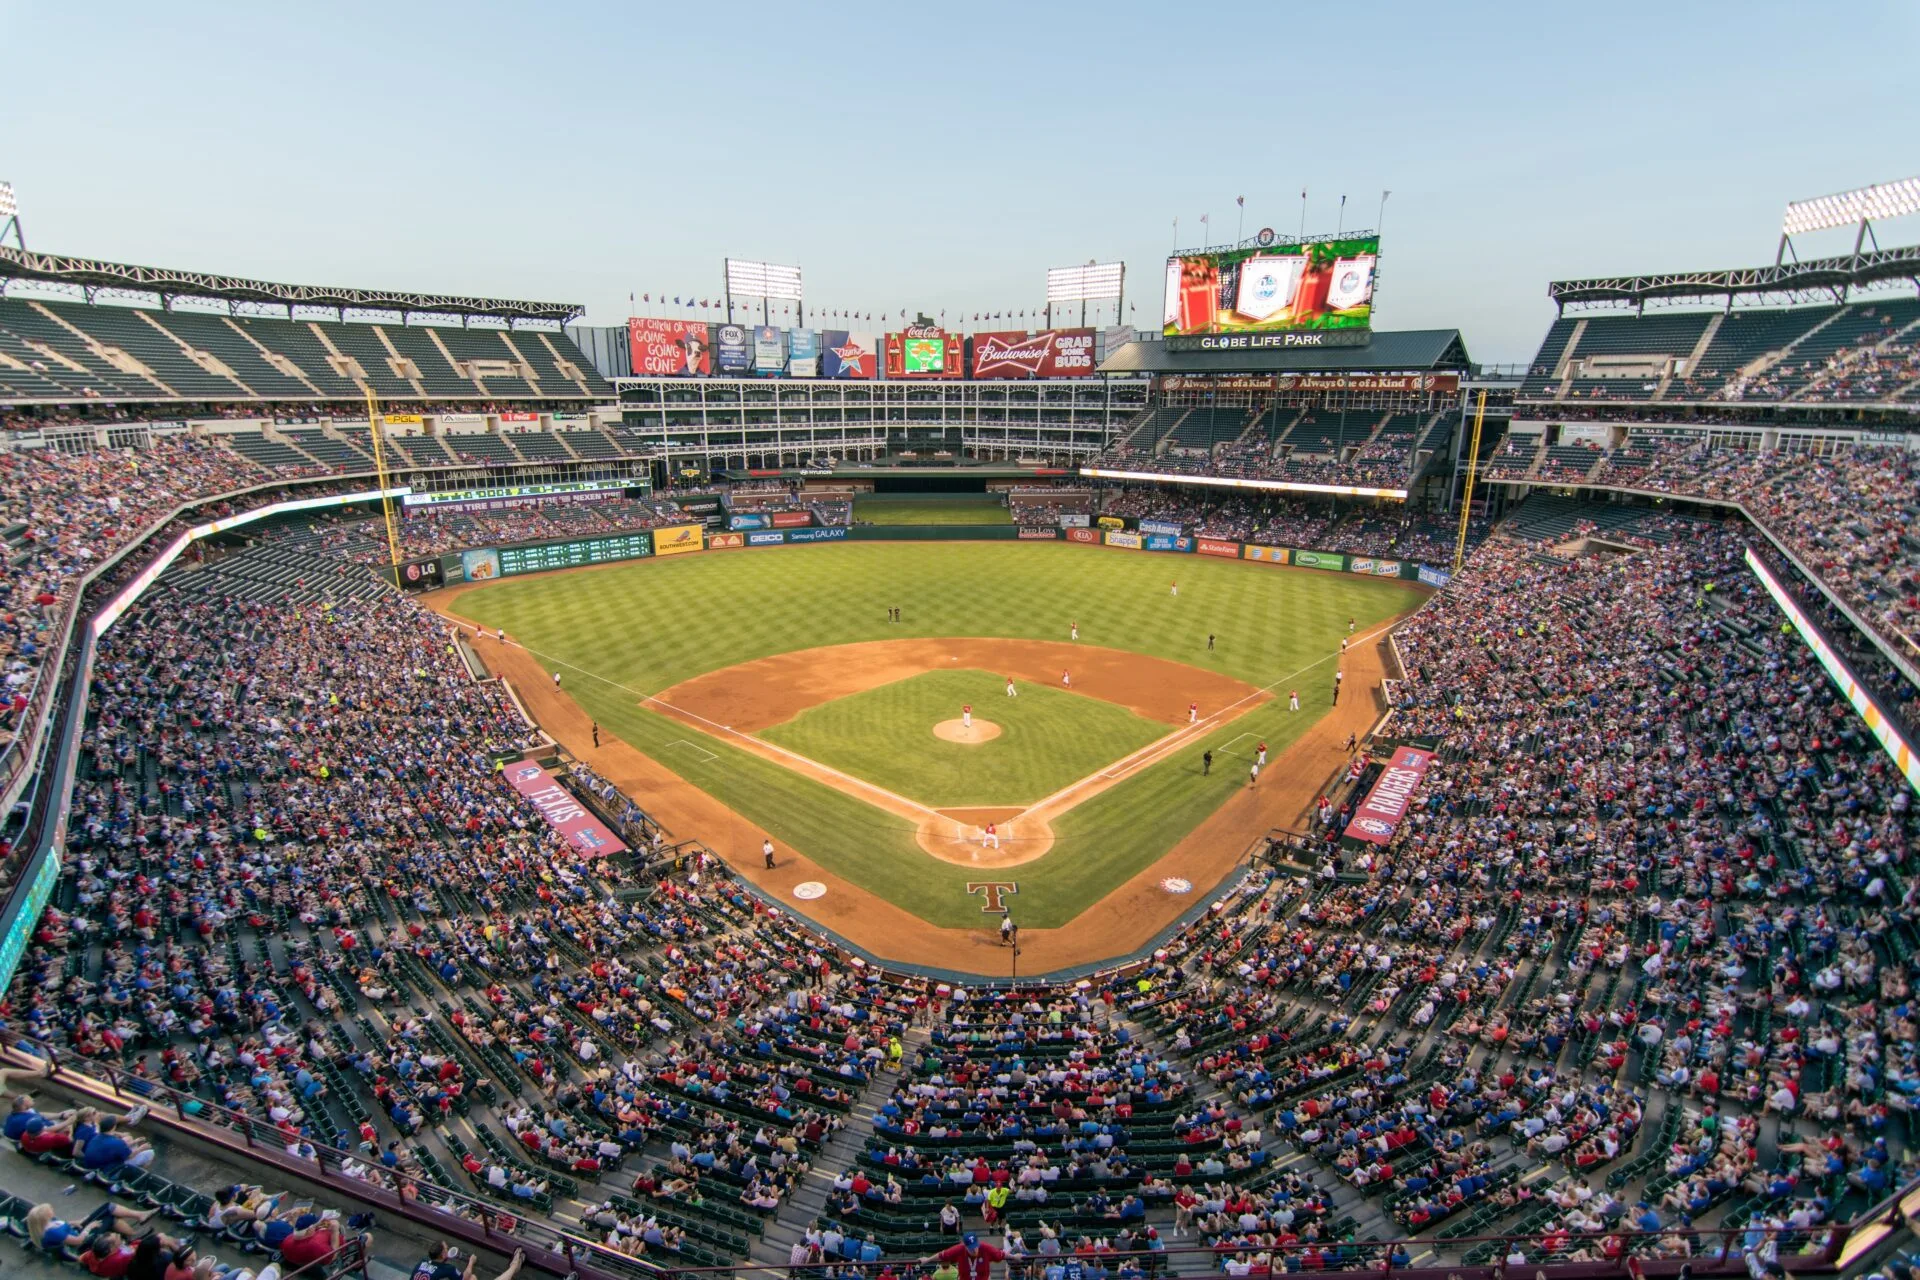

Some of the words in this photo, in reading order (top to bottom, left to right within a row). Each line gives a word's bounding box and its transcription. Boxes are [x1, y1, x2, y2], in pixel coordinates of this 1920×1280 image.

[631, 319, 645, 328] EAT
[647, 319, 671, 333] CHIKIN
[673, 321, 685, 333] OR
[635, 330, 666, 344] GOING
[724, 330, 739, 338] FOX
[1055, 336, 1092, 349] GRAB
[1201, 337, 1247, 348] GLOBE
[1251, 335, 1281, 347] LIFE
[1284, 334, 1322, 345] PARK
[647, 343, 680, 358] GOING
[976, 344, 1050, 361] Budweiser
[1061, 348, 1085, 356] SOME
[644, 357, 678, 373] GONE
[1054, 355, 1091, 368] BUDS
[1182, 379, 1213, 388] Always
[1248, 379, 1272, 388] Kind
[1299, 378, 1336, 388] Always
[1358, 378, 1371, 388] of
[1378, 378, 1405, 388] Kind
[393, 415, 415, 423] PGL
[573, 493, 601, 501] NEXEN
[464, 502, 488, 511] TIRE
[791, 532, 815, 541] Samsung
[815, 529, 845, 539] GALAXY
[1019, 526, 1037, 534] FRED
[1038, 526, 1056, 534] LOYA
[1077, 531, 1089, 539] KIA
[750, 533, 784, 543] GEICO
[1109, 534, 1137, 547] Snapple
[659, 540, 699, 549] SOUTHWEST.COM
[421, 563, 436, 576] LG
[1352, 562, 1372, 570] Gulf
[1378, 565, 1398, 574] Gulf
[1366, 767, 1419, 816] RANGERS
[529, 785, 586, 823] TEXAS
[966, 881, 1017, 913] T
